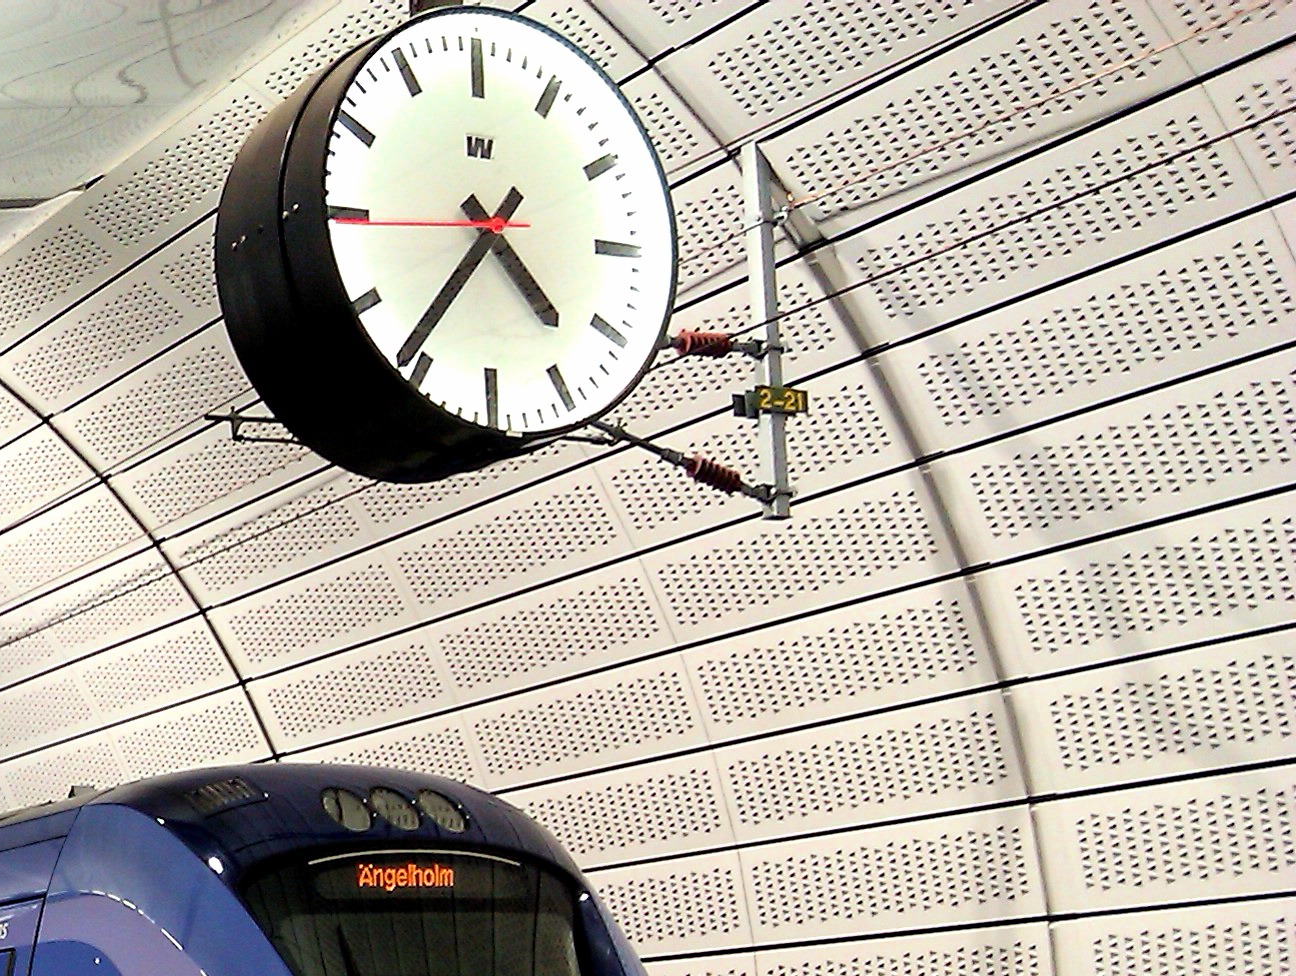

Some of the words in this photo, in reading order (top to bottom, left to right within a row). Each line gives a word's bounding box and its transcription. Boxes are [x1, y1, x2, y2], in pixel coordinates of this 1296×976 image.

[466, 135, 494, 160] W
[759, 390, 804, 411] 2-21
[357, 863, 454, 892] Ängelholm
